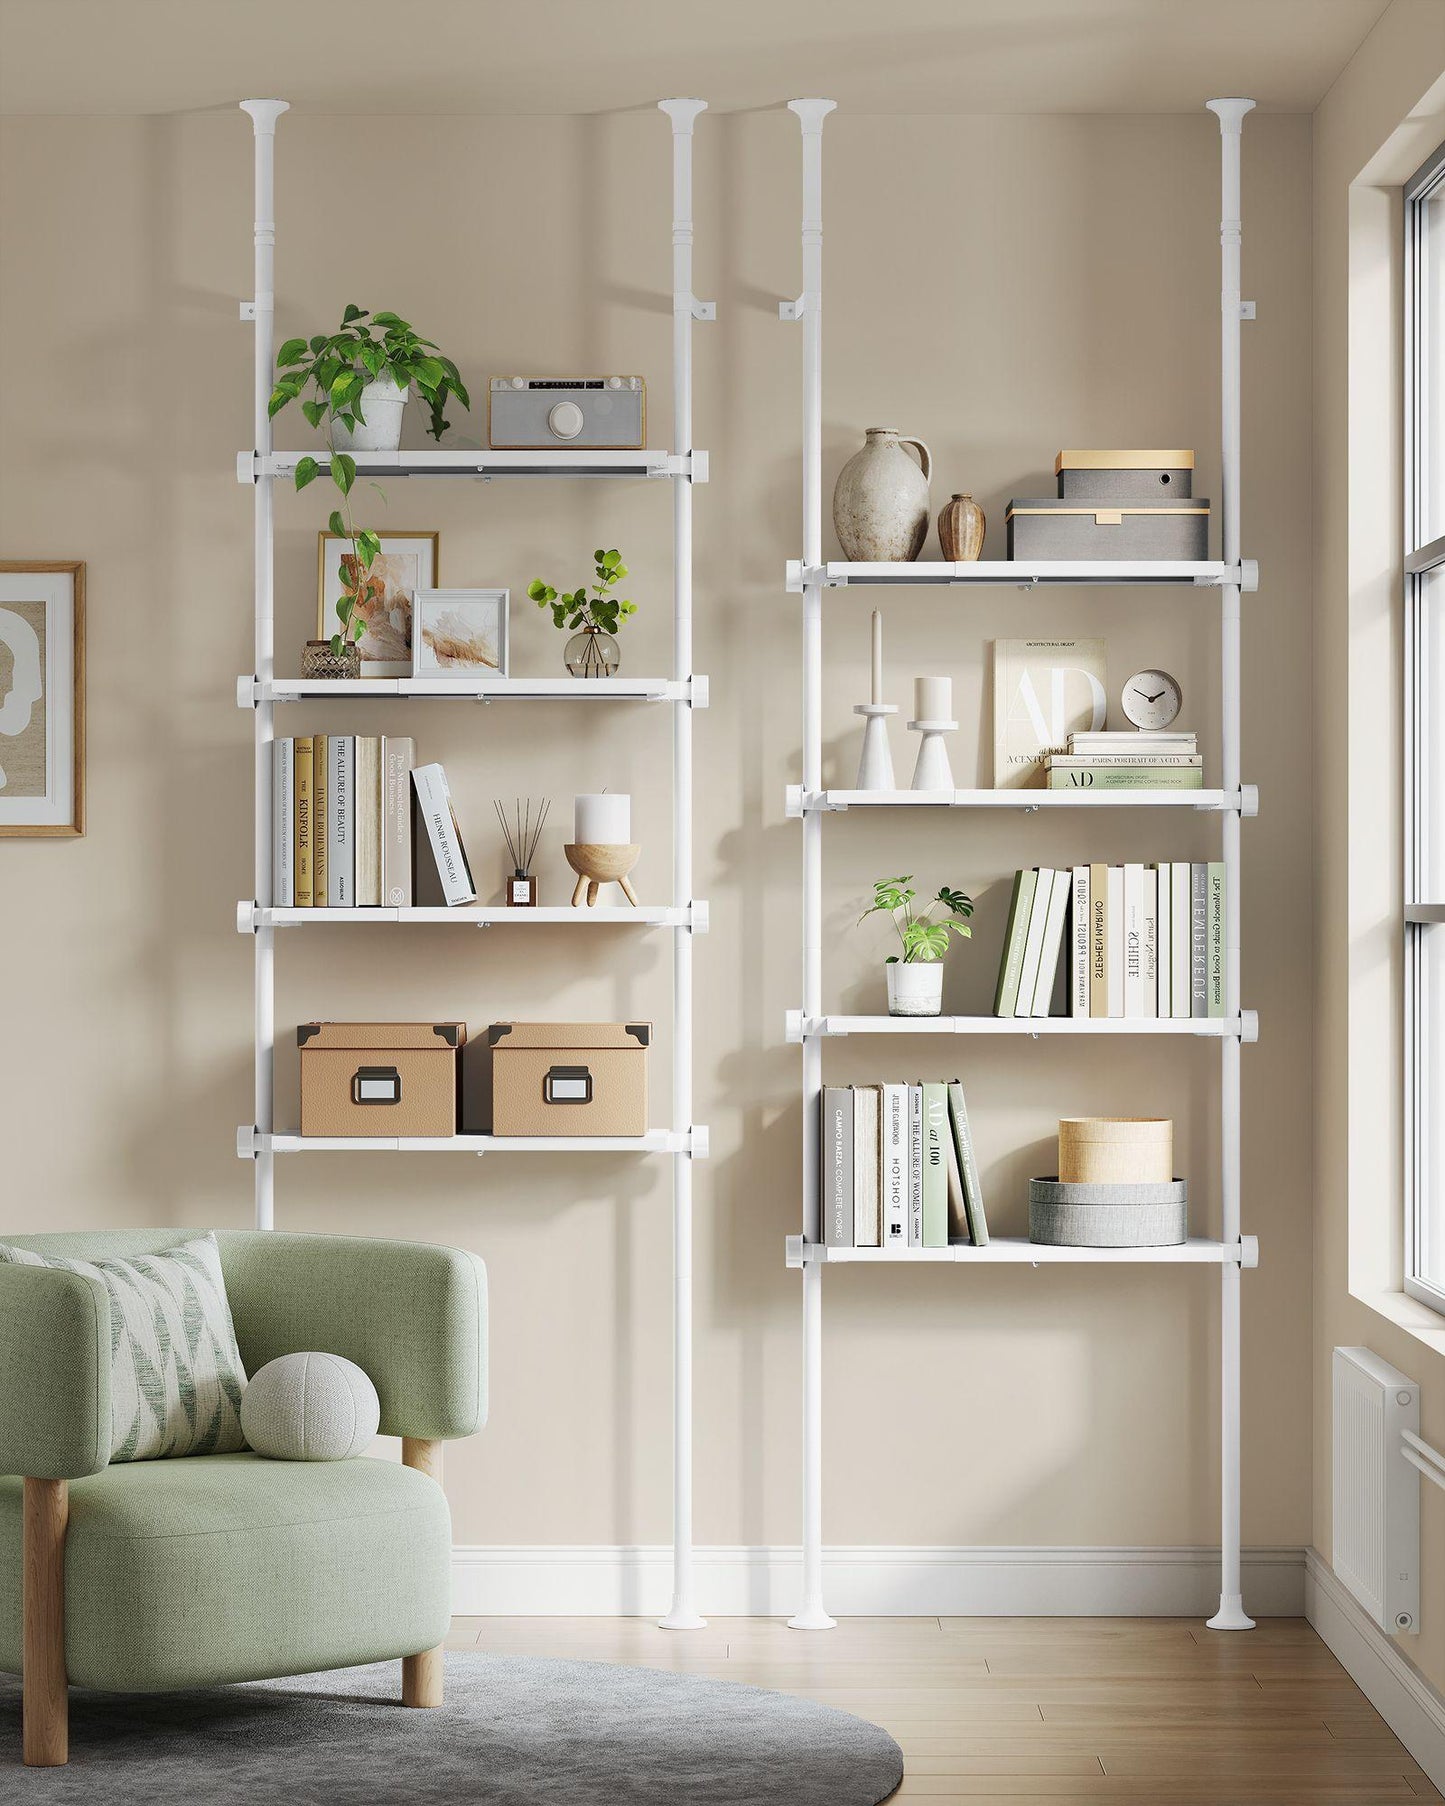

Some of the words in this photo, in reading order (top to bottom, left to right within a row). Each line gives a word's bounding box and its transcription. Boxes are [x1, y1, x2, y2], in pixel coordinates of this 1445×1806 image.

[996, 667, 1107, 745] AD
[337, 739, 345, 757] THE
[397, 753, 405, 770] The
[1014, 755, 1046, 764] CENTU
[337, 758, 345, 794] ALLURE
[1065, 771, 1093, 787] AD
[337, 795, 345, 807] OF
[300, 799, 308, 848] KINFOLK
[337, 808, 345, 845] BEAUTY
[397, 807, 405, 832] Guide
[433, 813, 445, 840] HENRI
[441, 840, 458, 884] ROUSSEAU
[892, 1094, 900, 1113] JULIE
[928, 1097, 944, 1127] AD
[835, 1109, 843, 1139] CAMPO
[929, 1129, 939, 1142] at
[835, 1141, 843, 1168] BAEZA:
[929, 1146, 940, 1166] 100
[892, 1158, 900, 1209] HOTSHOT
[913, 1169, 920, 1180] OF
[835, 1170, 843, 1209] COMPLETE
[835, 1210, 843, 1239] WORKS
